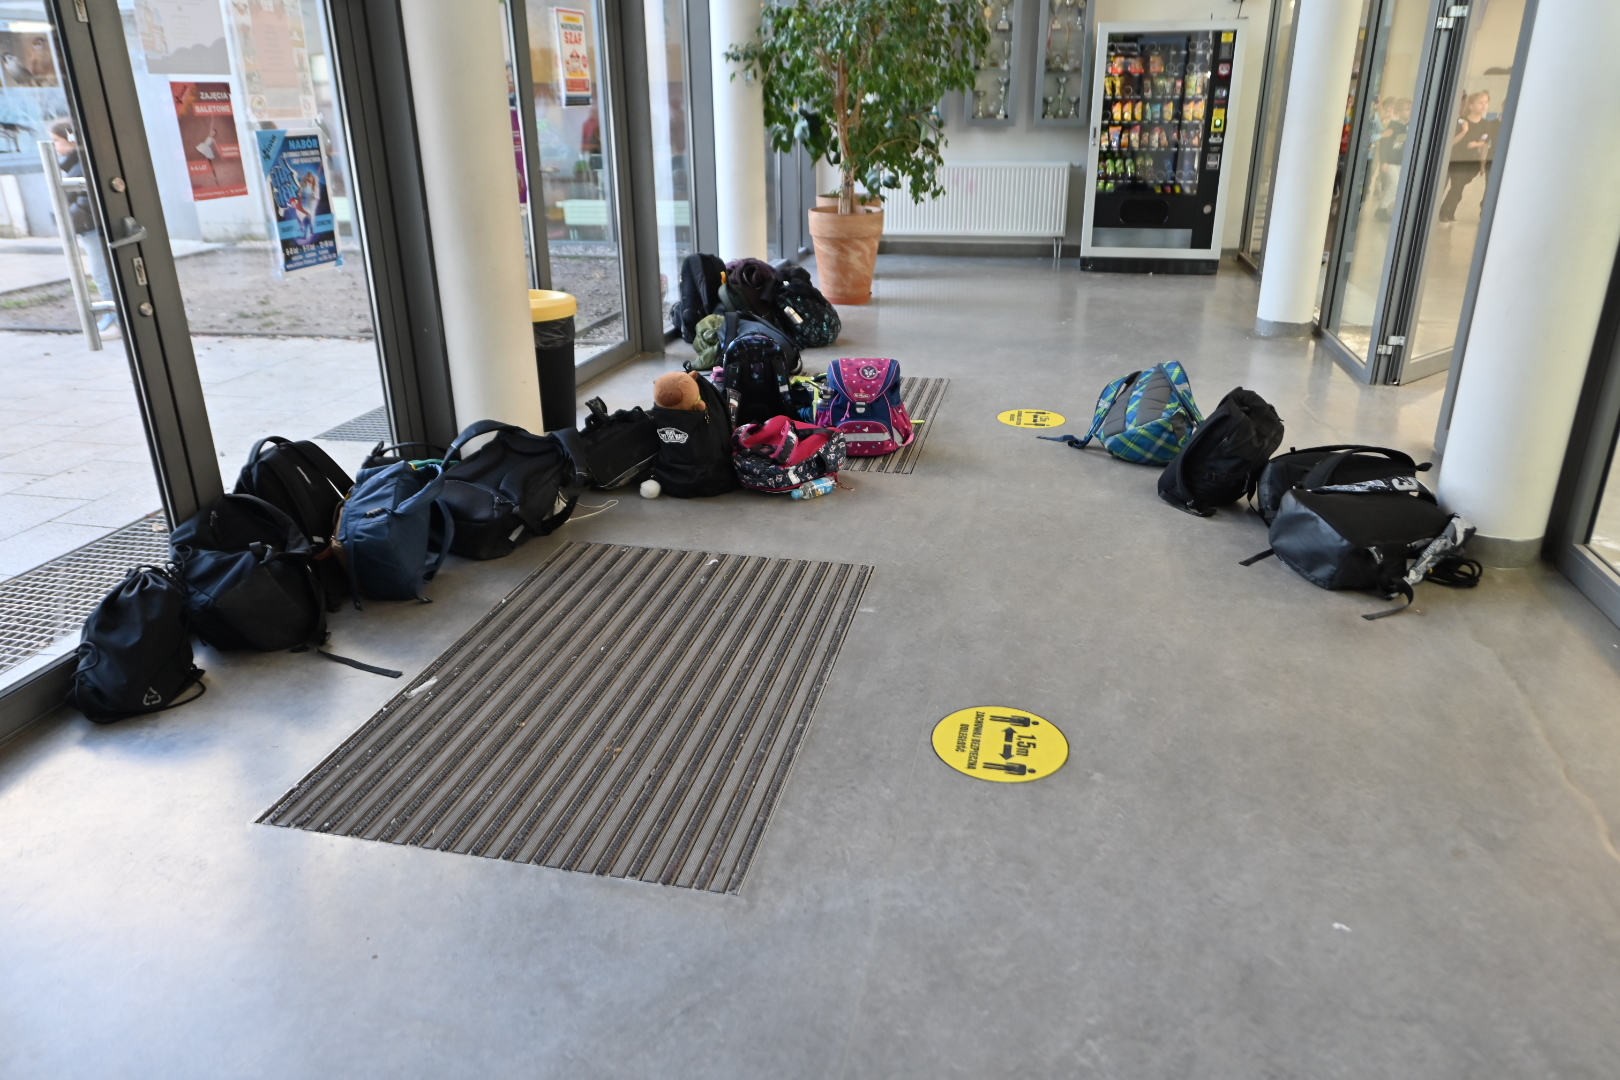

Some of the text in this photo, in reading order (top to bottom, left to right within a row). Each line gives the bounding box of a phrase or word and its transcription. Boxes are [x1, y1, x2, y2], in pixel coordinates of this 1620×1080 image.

[199, 91, 229, 101] ZAJĘCIA
[195, 105, 231, 113] BALETOWE
[288, 137, 318, 150] NABÓR
[1015, 735, 1037, 757] 1,5m
